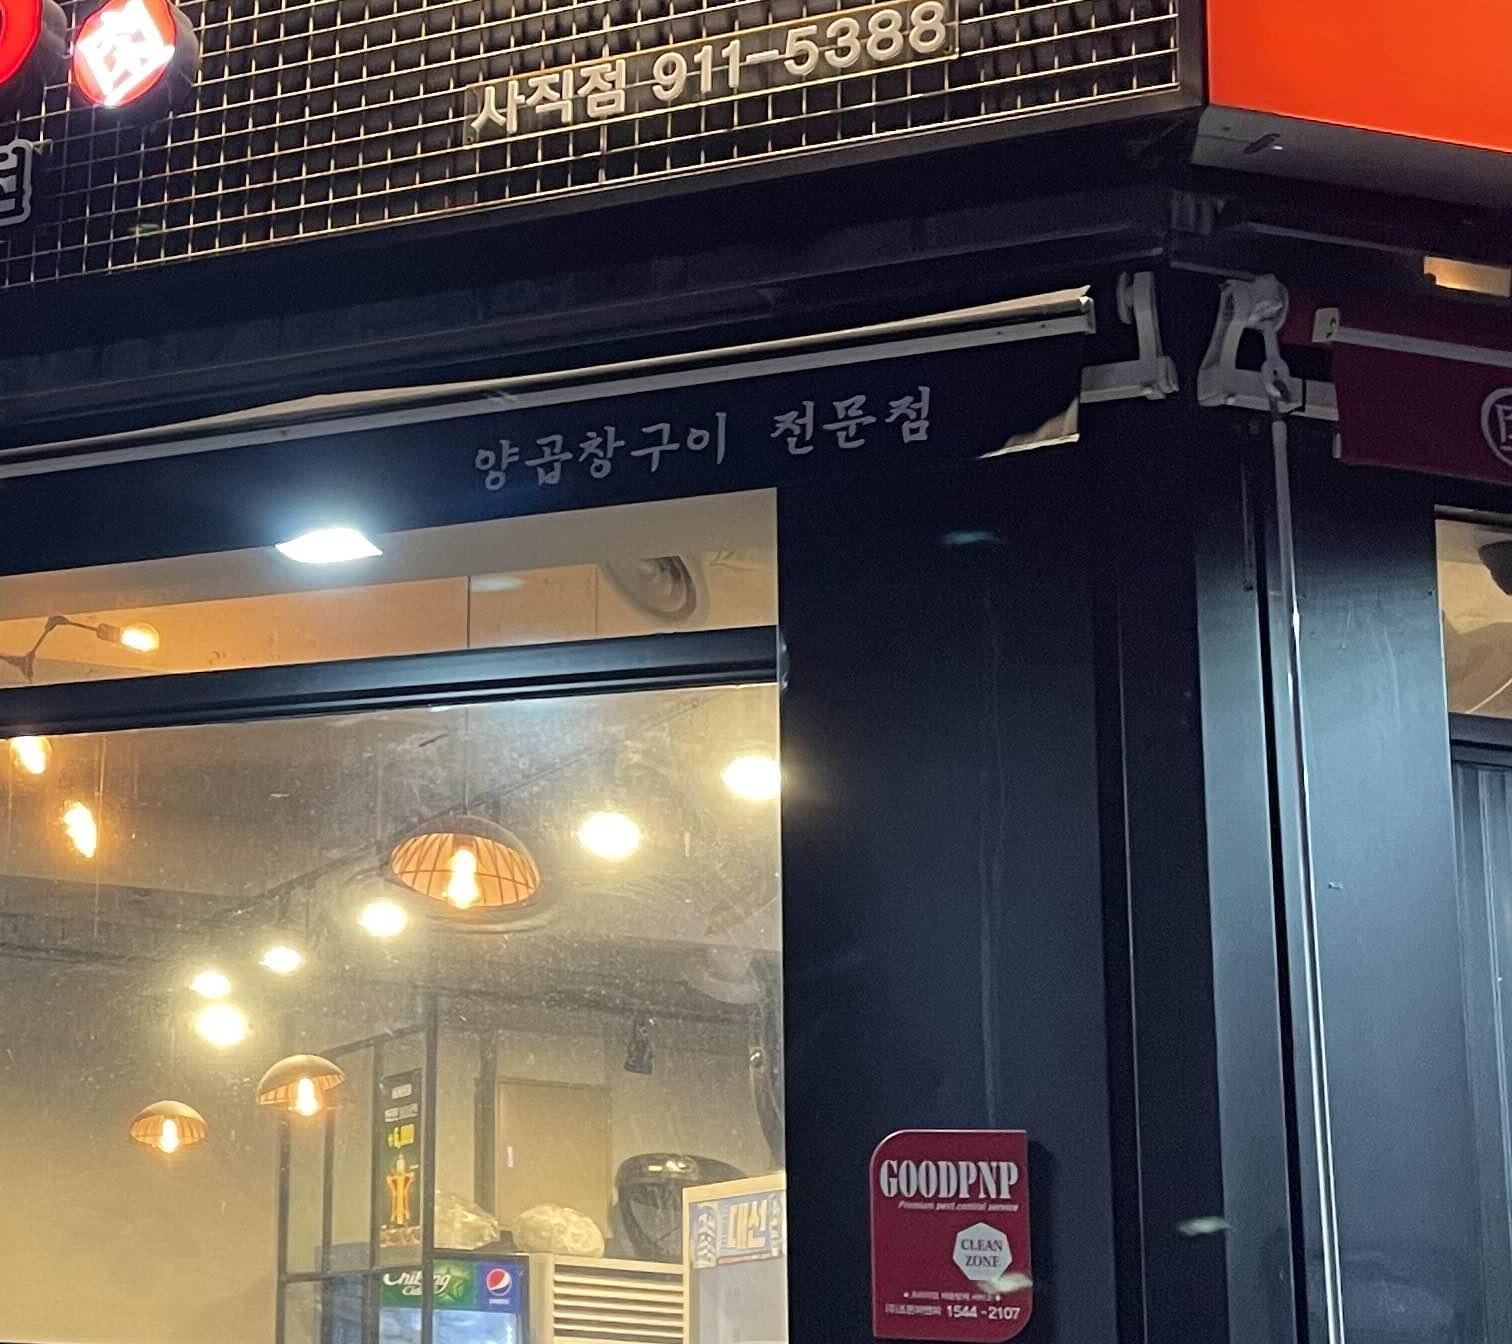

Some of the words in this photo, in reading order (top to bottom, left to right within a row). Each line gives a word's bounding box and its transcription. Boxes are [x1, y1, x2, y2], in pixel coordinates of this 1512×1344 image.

[469, 57, 628, 137] 사직점
[651, 0, 948, 102] 911-5388
[474, 411, 728, 490] 양곱창구이
[769, 385, 933, 456] 전문점
[879, 1159, 1020, 1199] GOODPNP
[960, 1239, 1004, 1252] CLEAN
[964, 1254, 1000, 1267] ZONE
